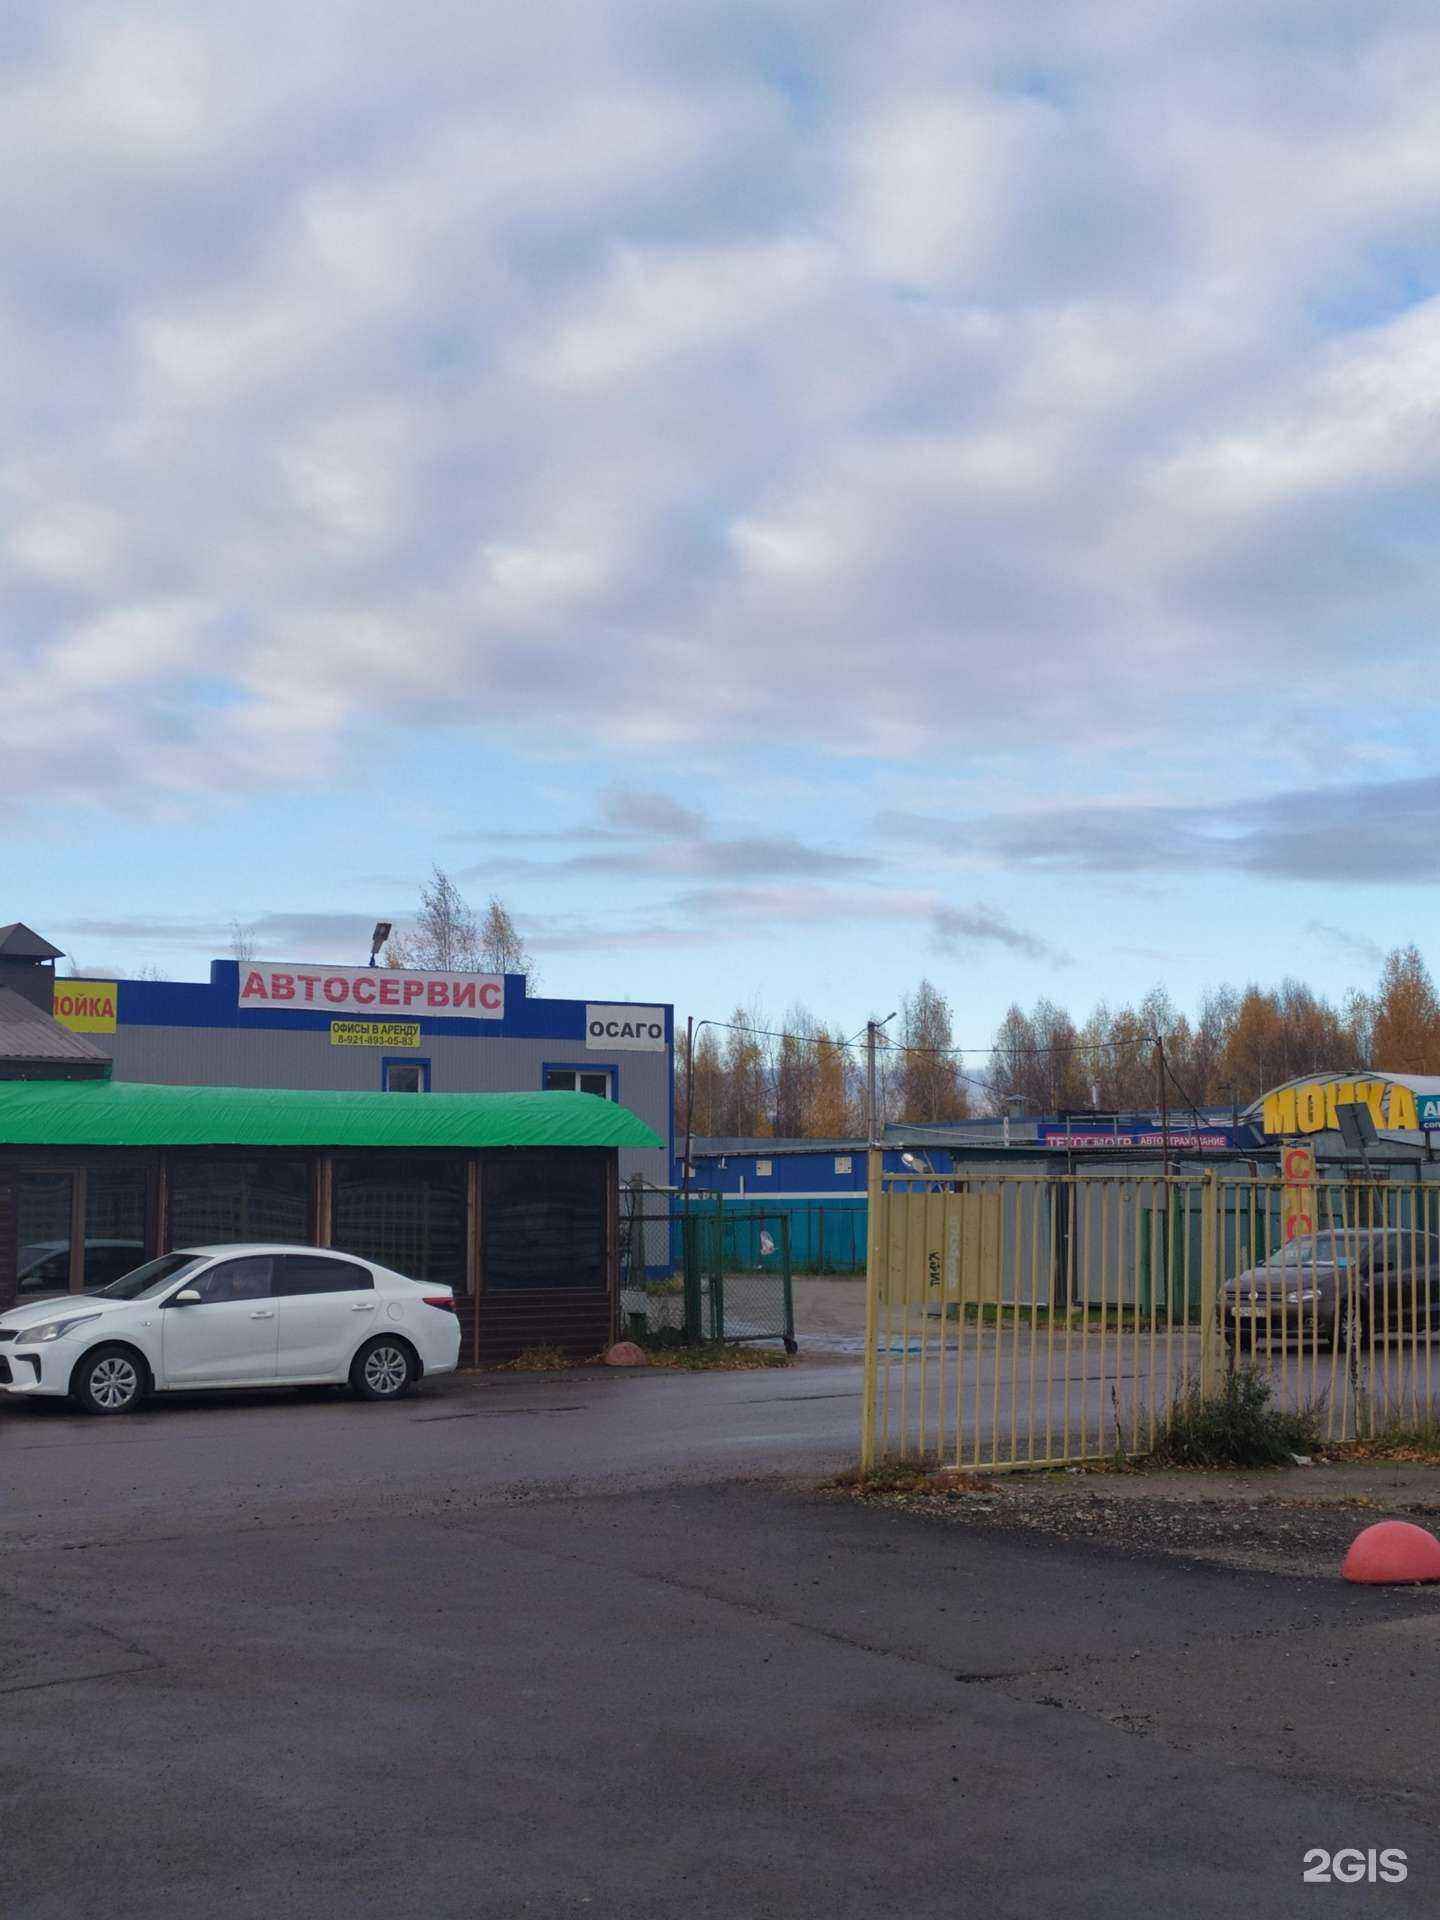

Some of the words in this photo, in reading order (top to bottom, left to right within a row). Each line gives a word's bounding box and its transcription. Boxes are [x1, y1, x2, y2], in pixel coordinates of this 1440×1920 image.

[241, 971, 502, 1009] АВТОСЕРВИС
[332, 1022, 370, 1034] ОФИСЫ
[372, 1024, 379, 1034] В
[380, 1024, 418, 1036] АРЕНДУ
[589, 1021, 662, 1039] ОСАГО
